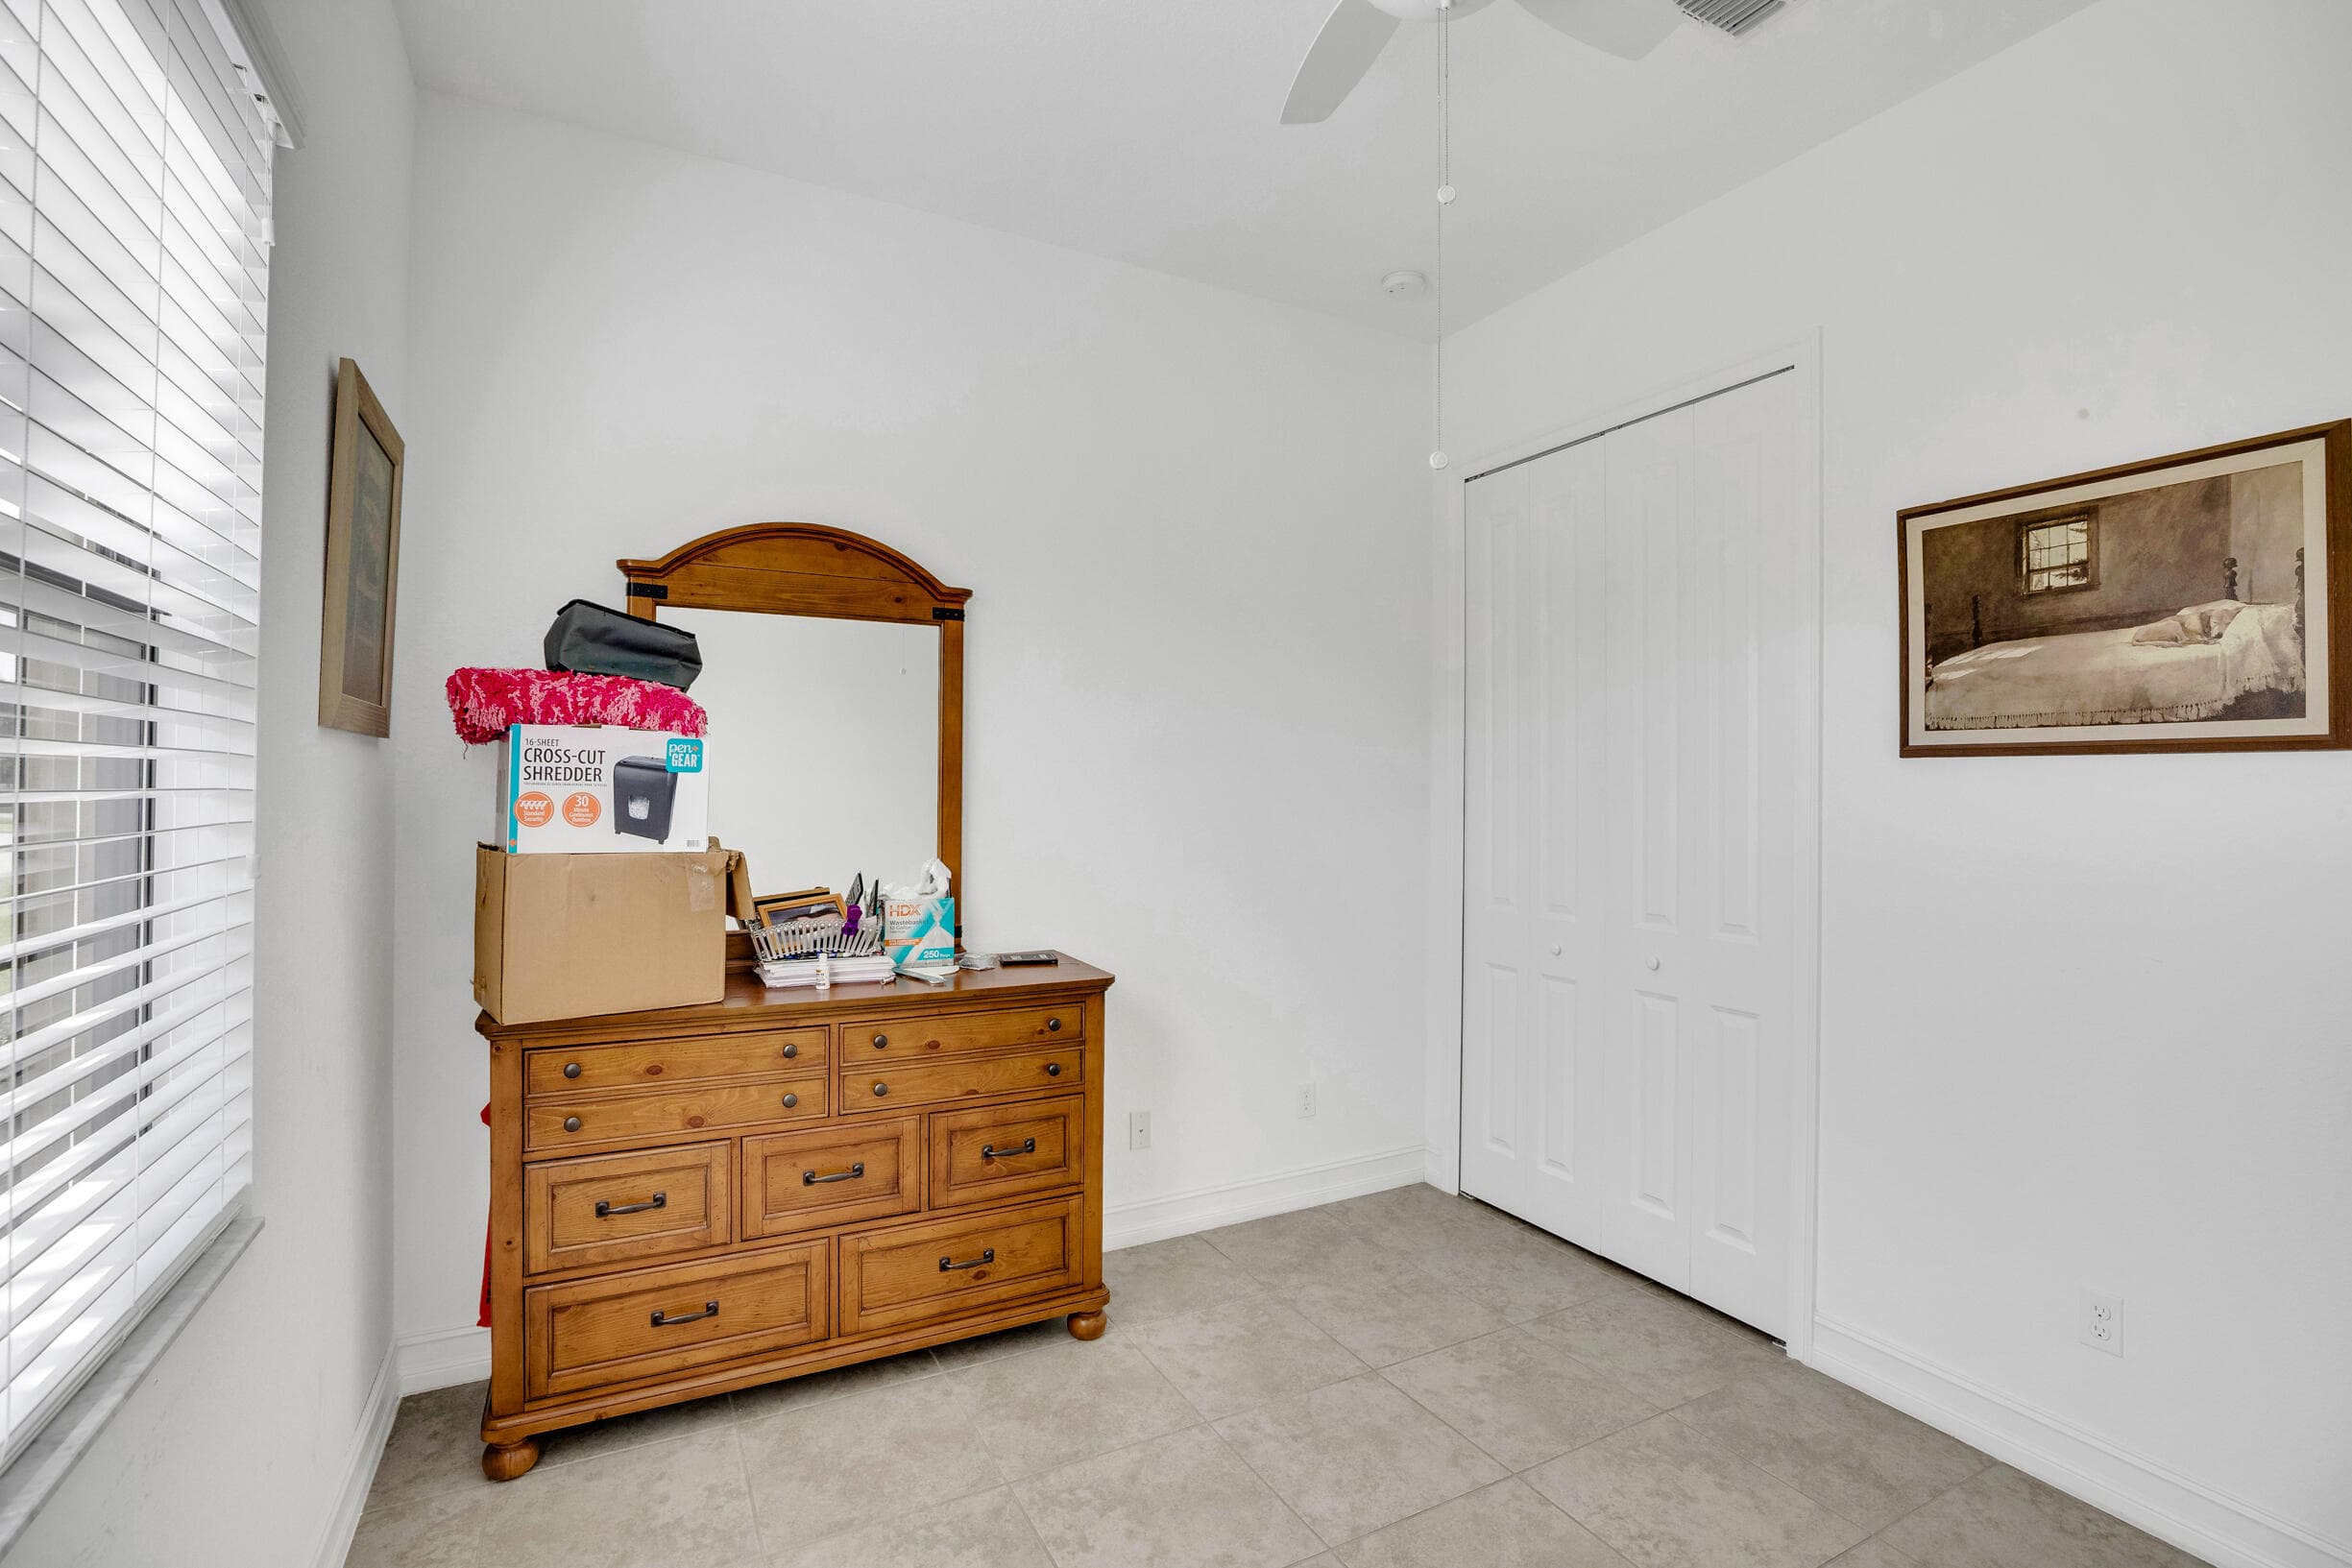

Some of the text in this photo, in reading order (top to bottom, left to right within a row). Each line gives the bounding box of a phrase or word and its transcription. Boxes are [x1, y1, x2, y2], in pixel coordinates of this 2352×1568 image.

[525, 738, 560, 747] 16-SHEET
[523, 747, 606, 764] CROSS-CUT
[671, 754, 697, 767] GEAR
[523, 765, 602, 782] SHREDDER
[575, 795, 589, 808] 30
[889, 905, 922, 917] HDX
[923, 949, 939, 959] 250
